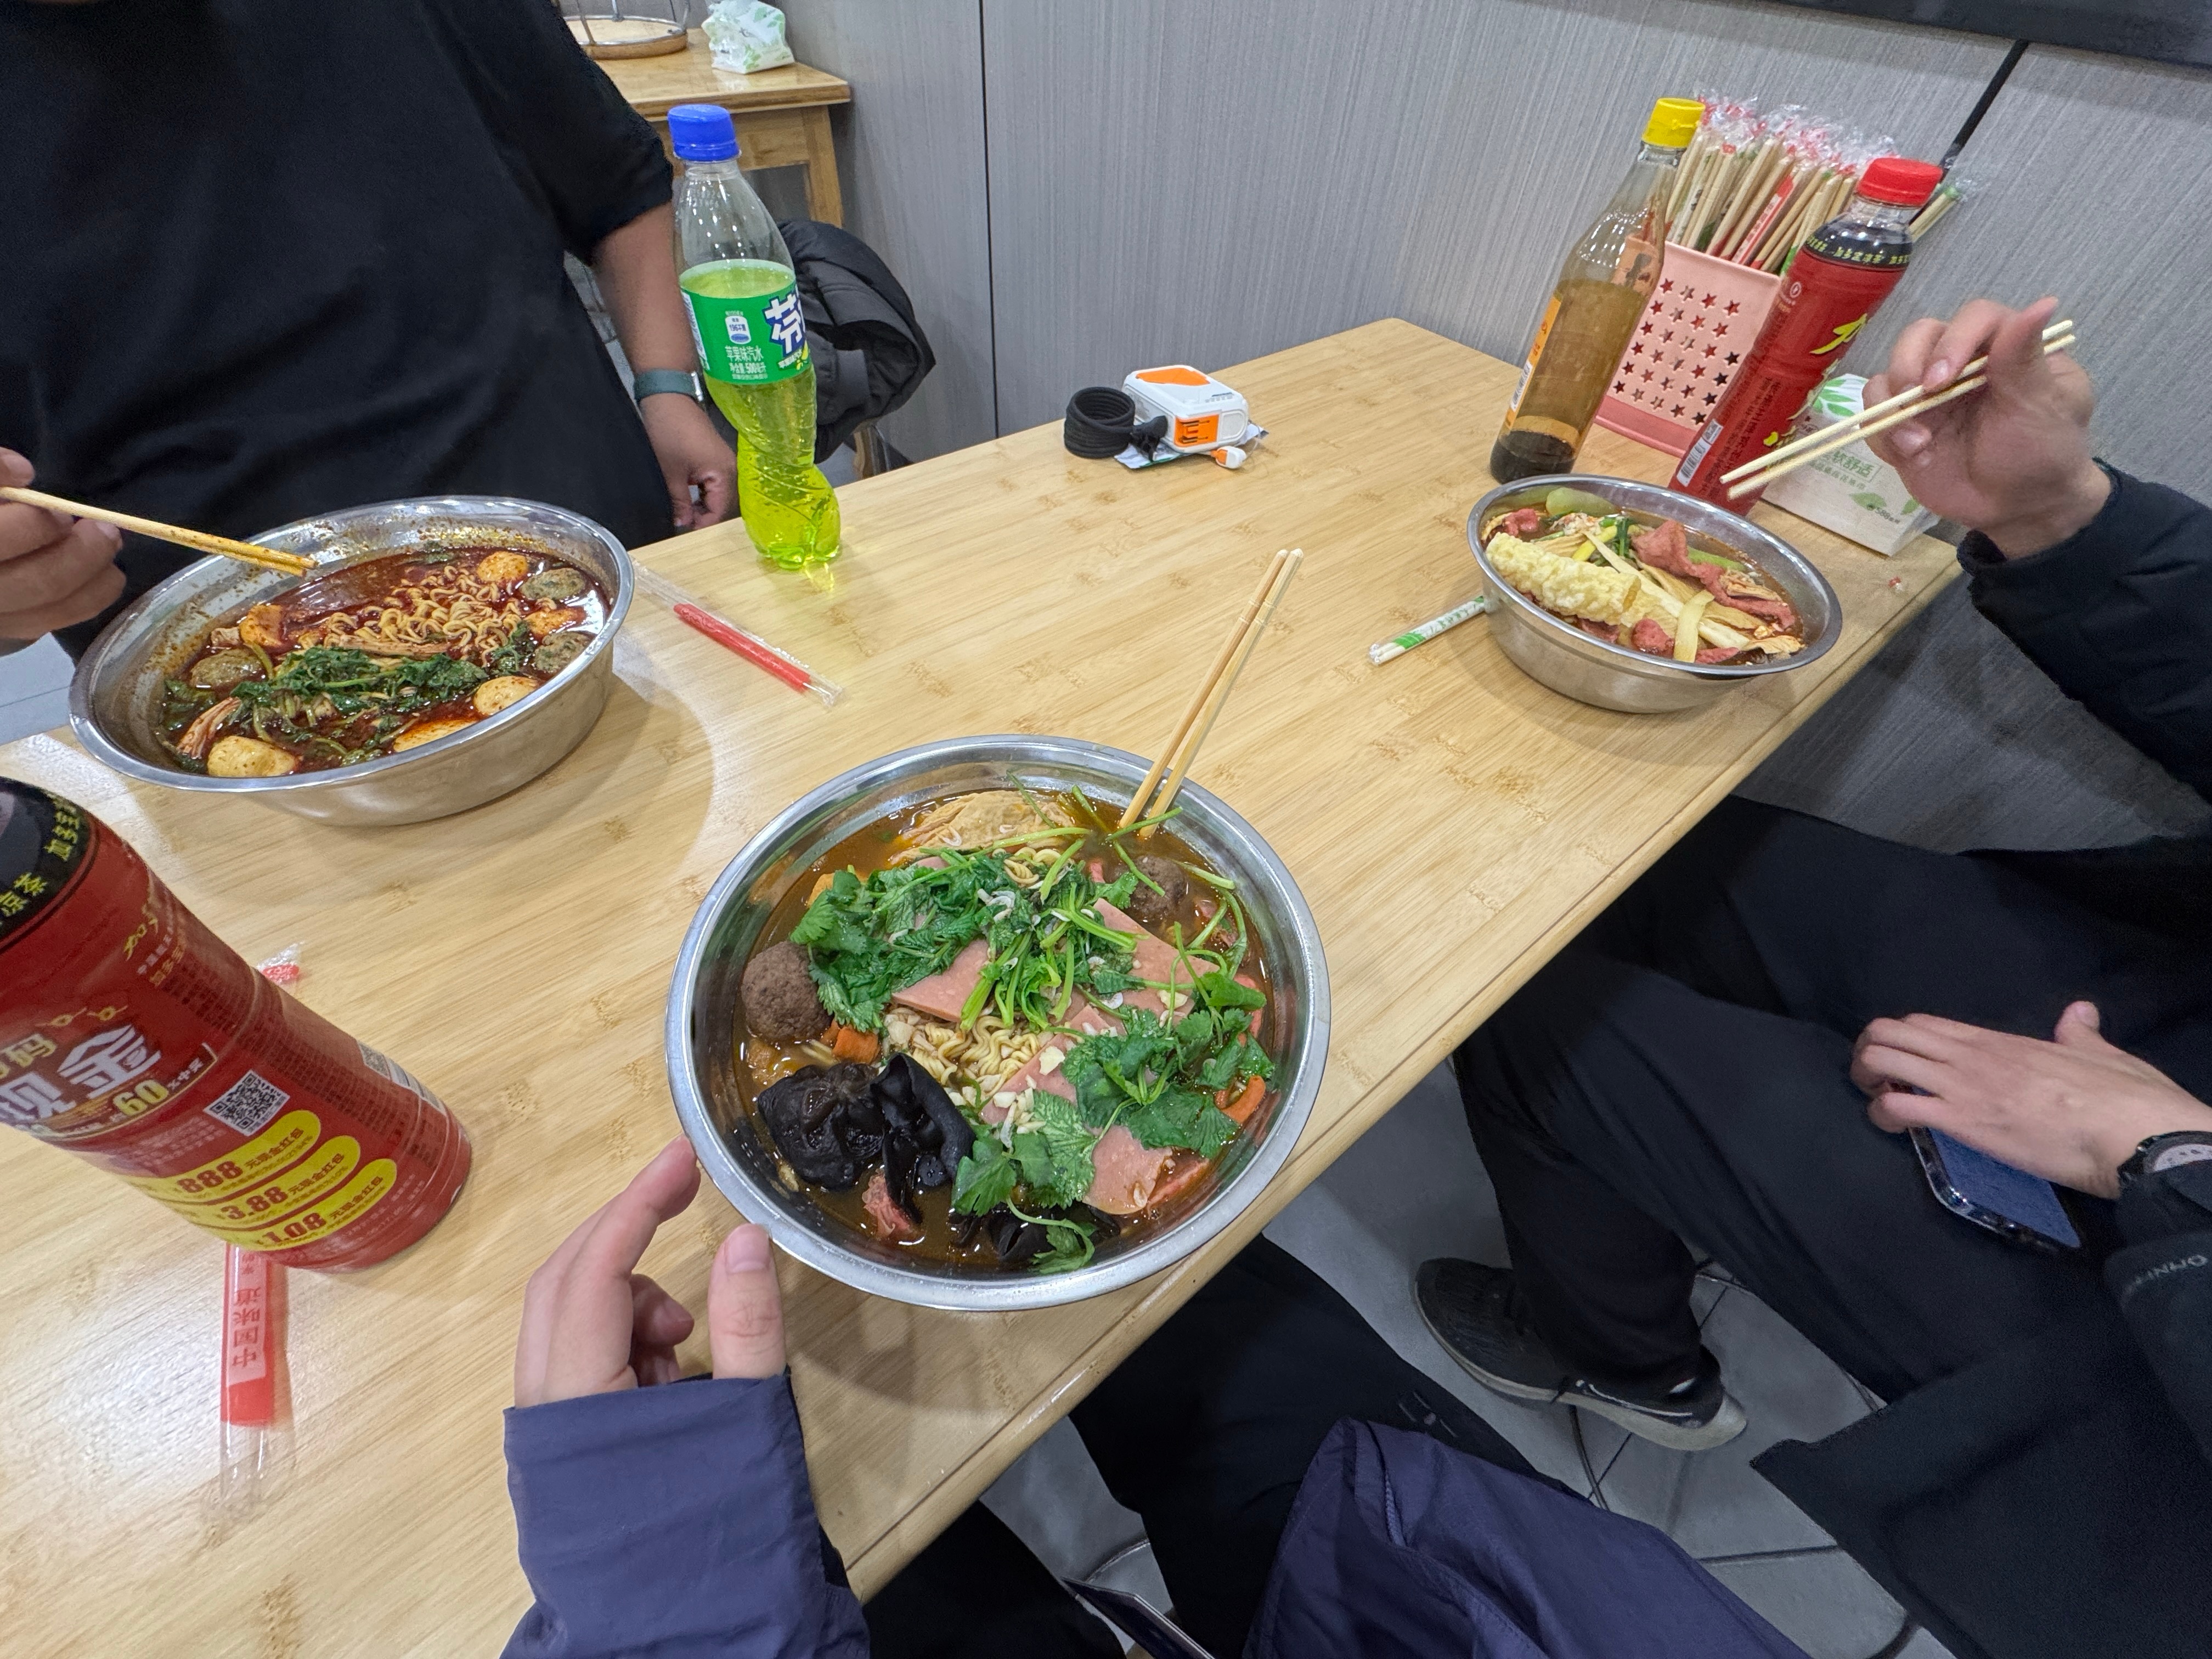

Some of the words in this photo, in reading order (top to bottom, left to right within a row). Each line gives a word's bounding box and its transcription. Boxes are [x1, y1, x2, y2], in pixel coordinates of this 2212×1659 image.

[764, 284, 806, 354] 芬
[725, 345, 764, 362] 苹果味汽水
